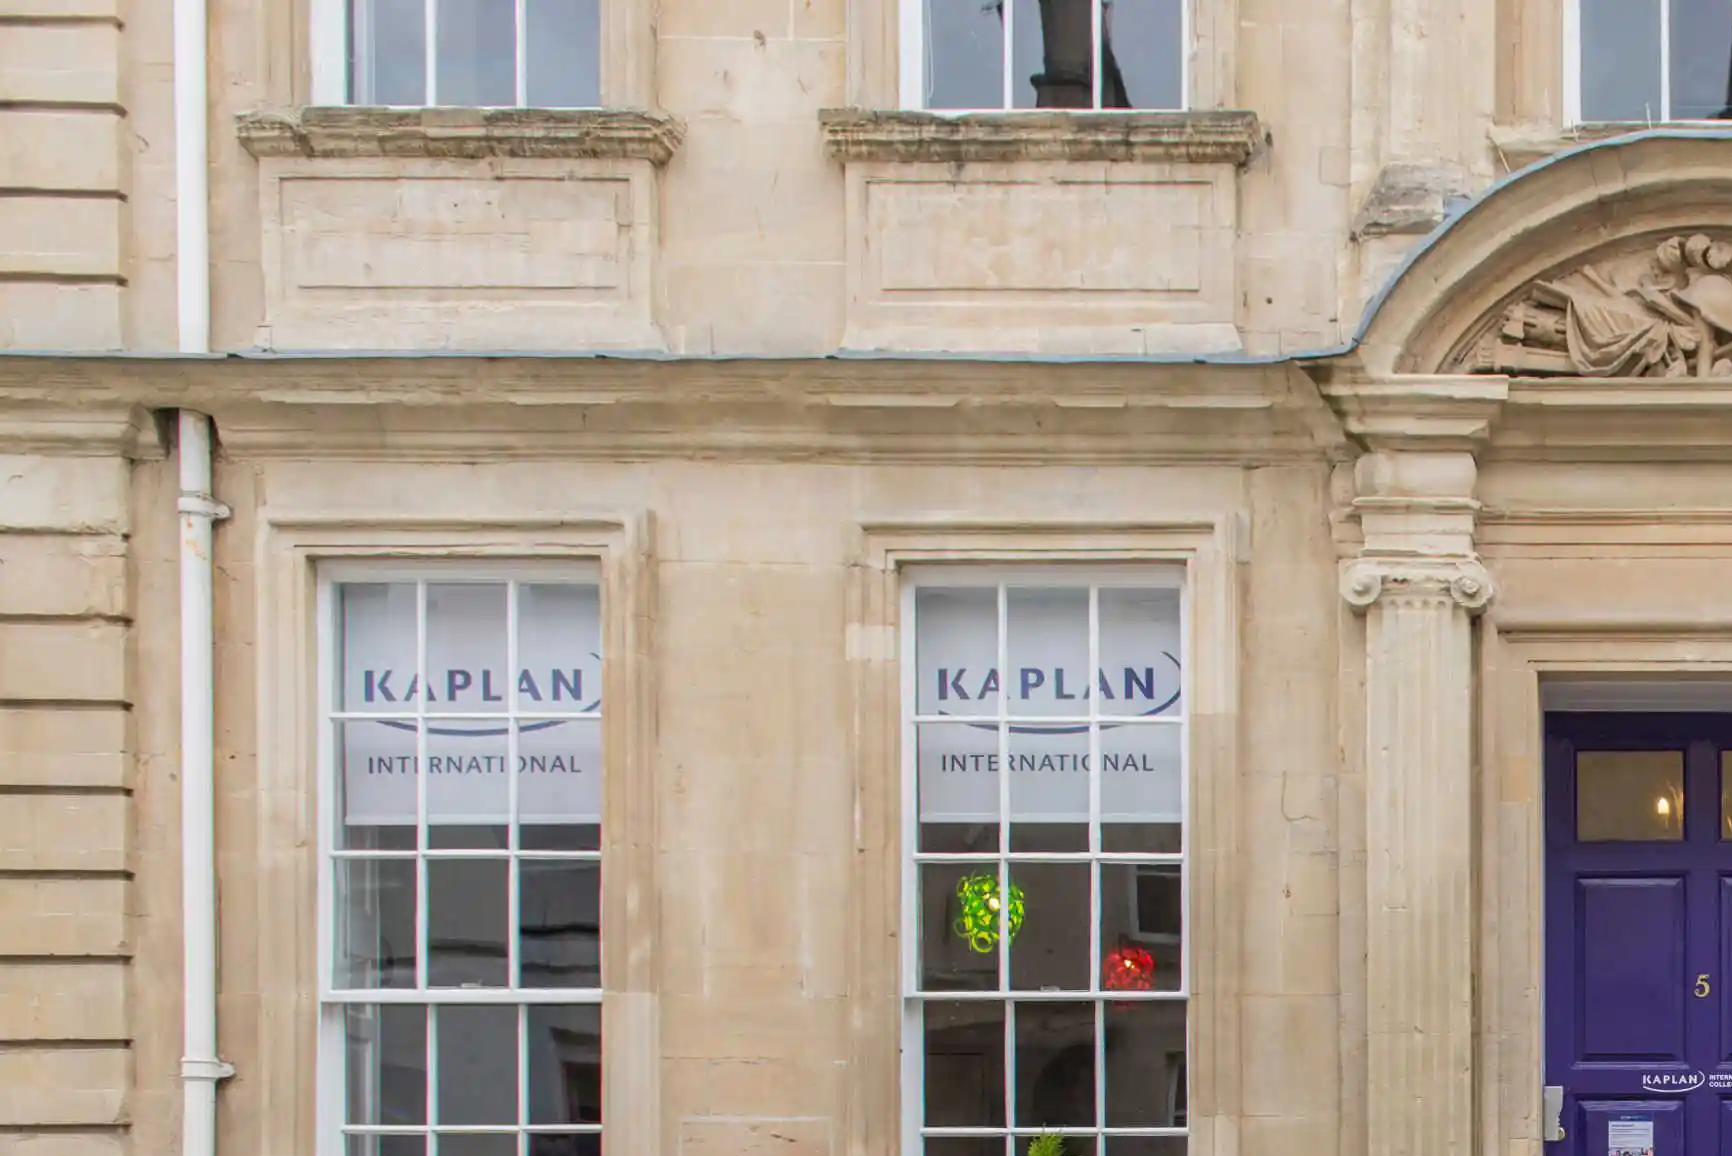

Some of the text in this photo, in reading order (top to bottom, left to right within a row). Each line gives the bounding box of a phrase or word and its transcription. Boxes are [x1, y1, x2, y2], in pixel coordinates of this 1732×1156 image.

[363, 668, 583, 703] KAPLAN
[937, 666, 1155, 701] KAPLAN
[1694, 973, 1711, 998] 5
[1642, 1074, 1698, 1085] KAPLAN
